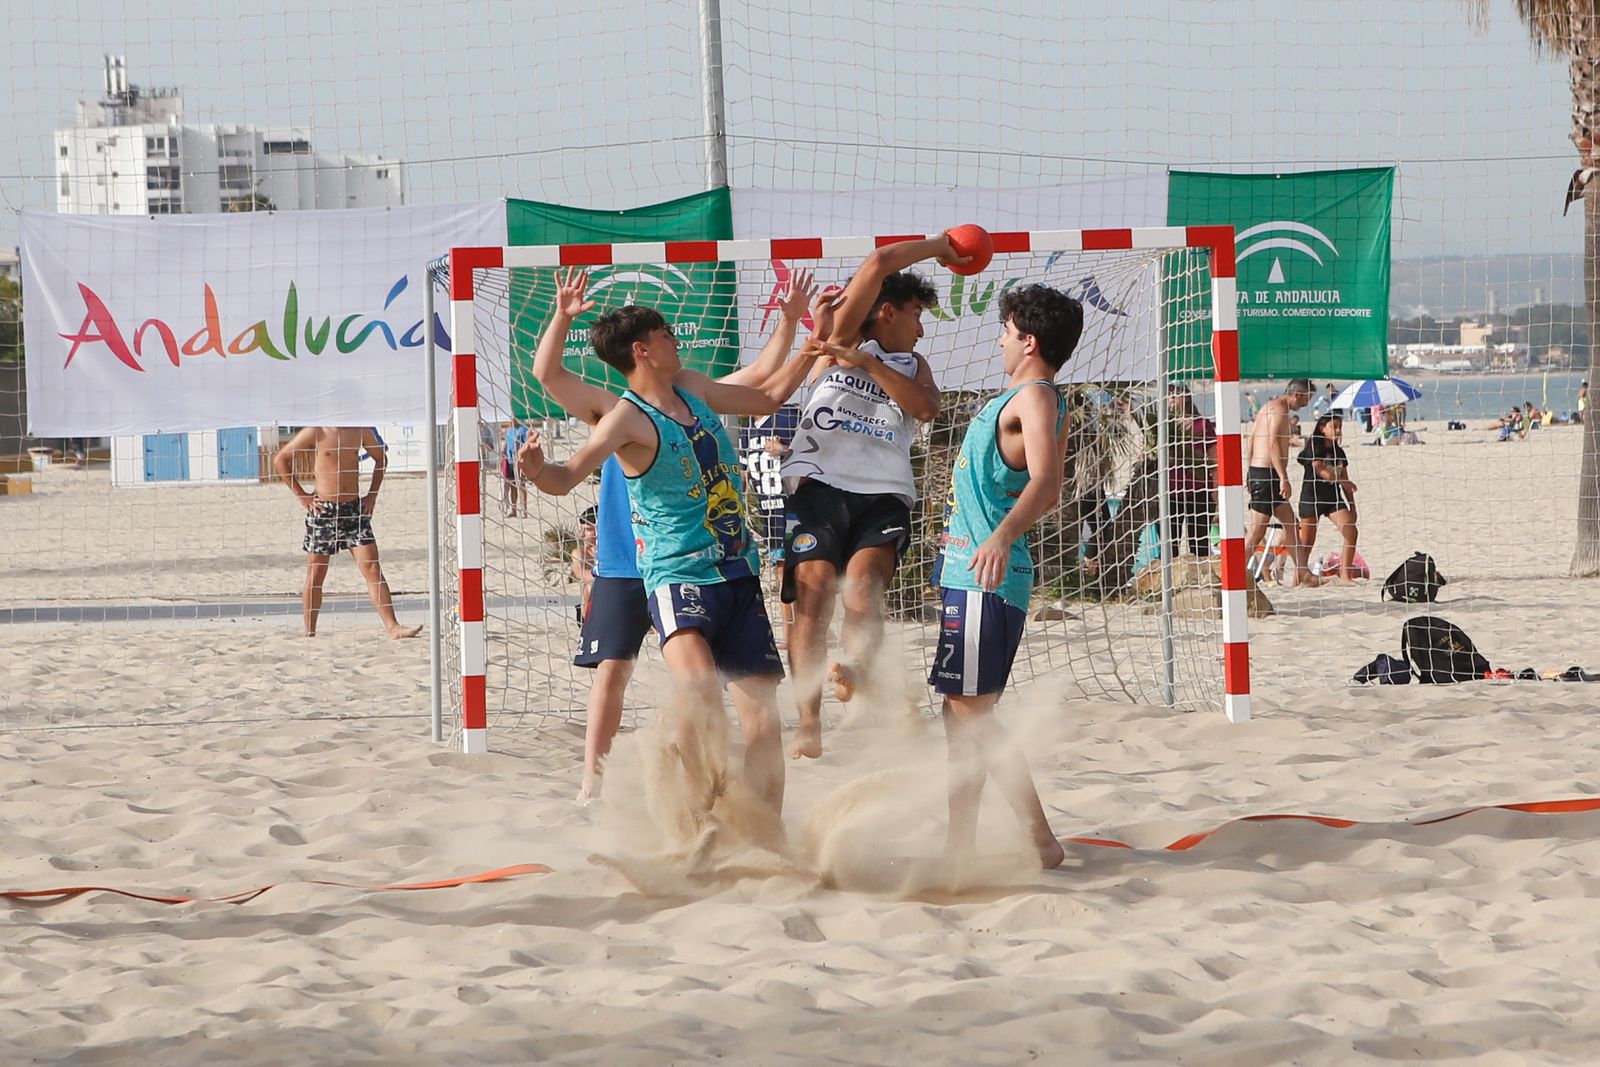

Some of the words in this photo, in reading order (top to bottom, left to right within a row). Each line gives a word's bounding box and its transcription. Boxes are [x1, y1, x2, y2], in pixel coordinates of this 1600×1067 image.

[1255, 290, 1269, 304] DE
[57, 274, 452, 372] Andalucía
[1282, 308, 1327, 318] COMERCIO
[1327, 309, 1333, 317] Y
[1334, 308, 1372, 318] DEPORTE
[824, 374, 891, 401] ALQUILE
[680, 456, 694, 479] 3
[942, 643, 955, 669] 7
